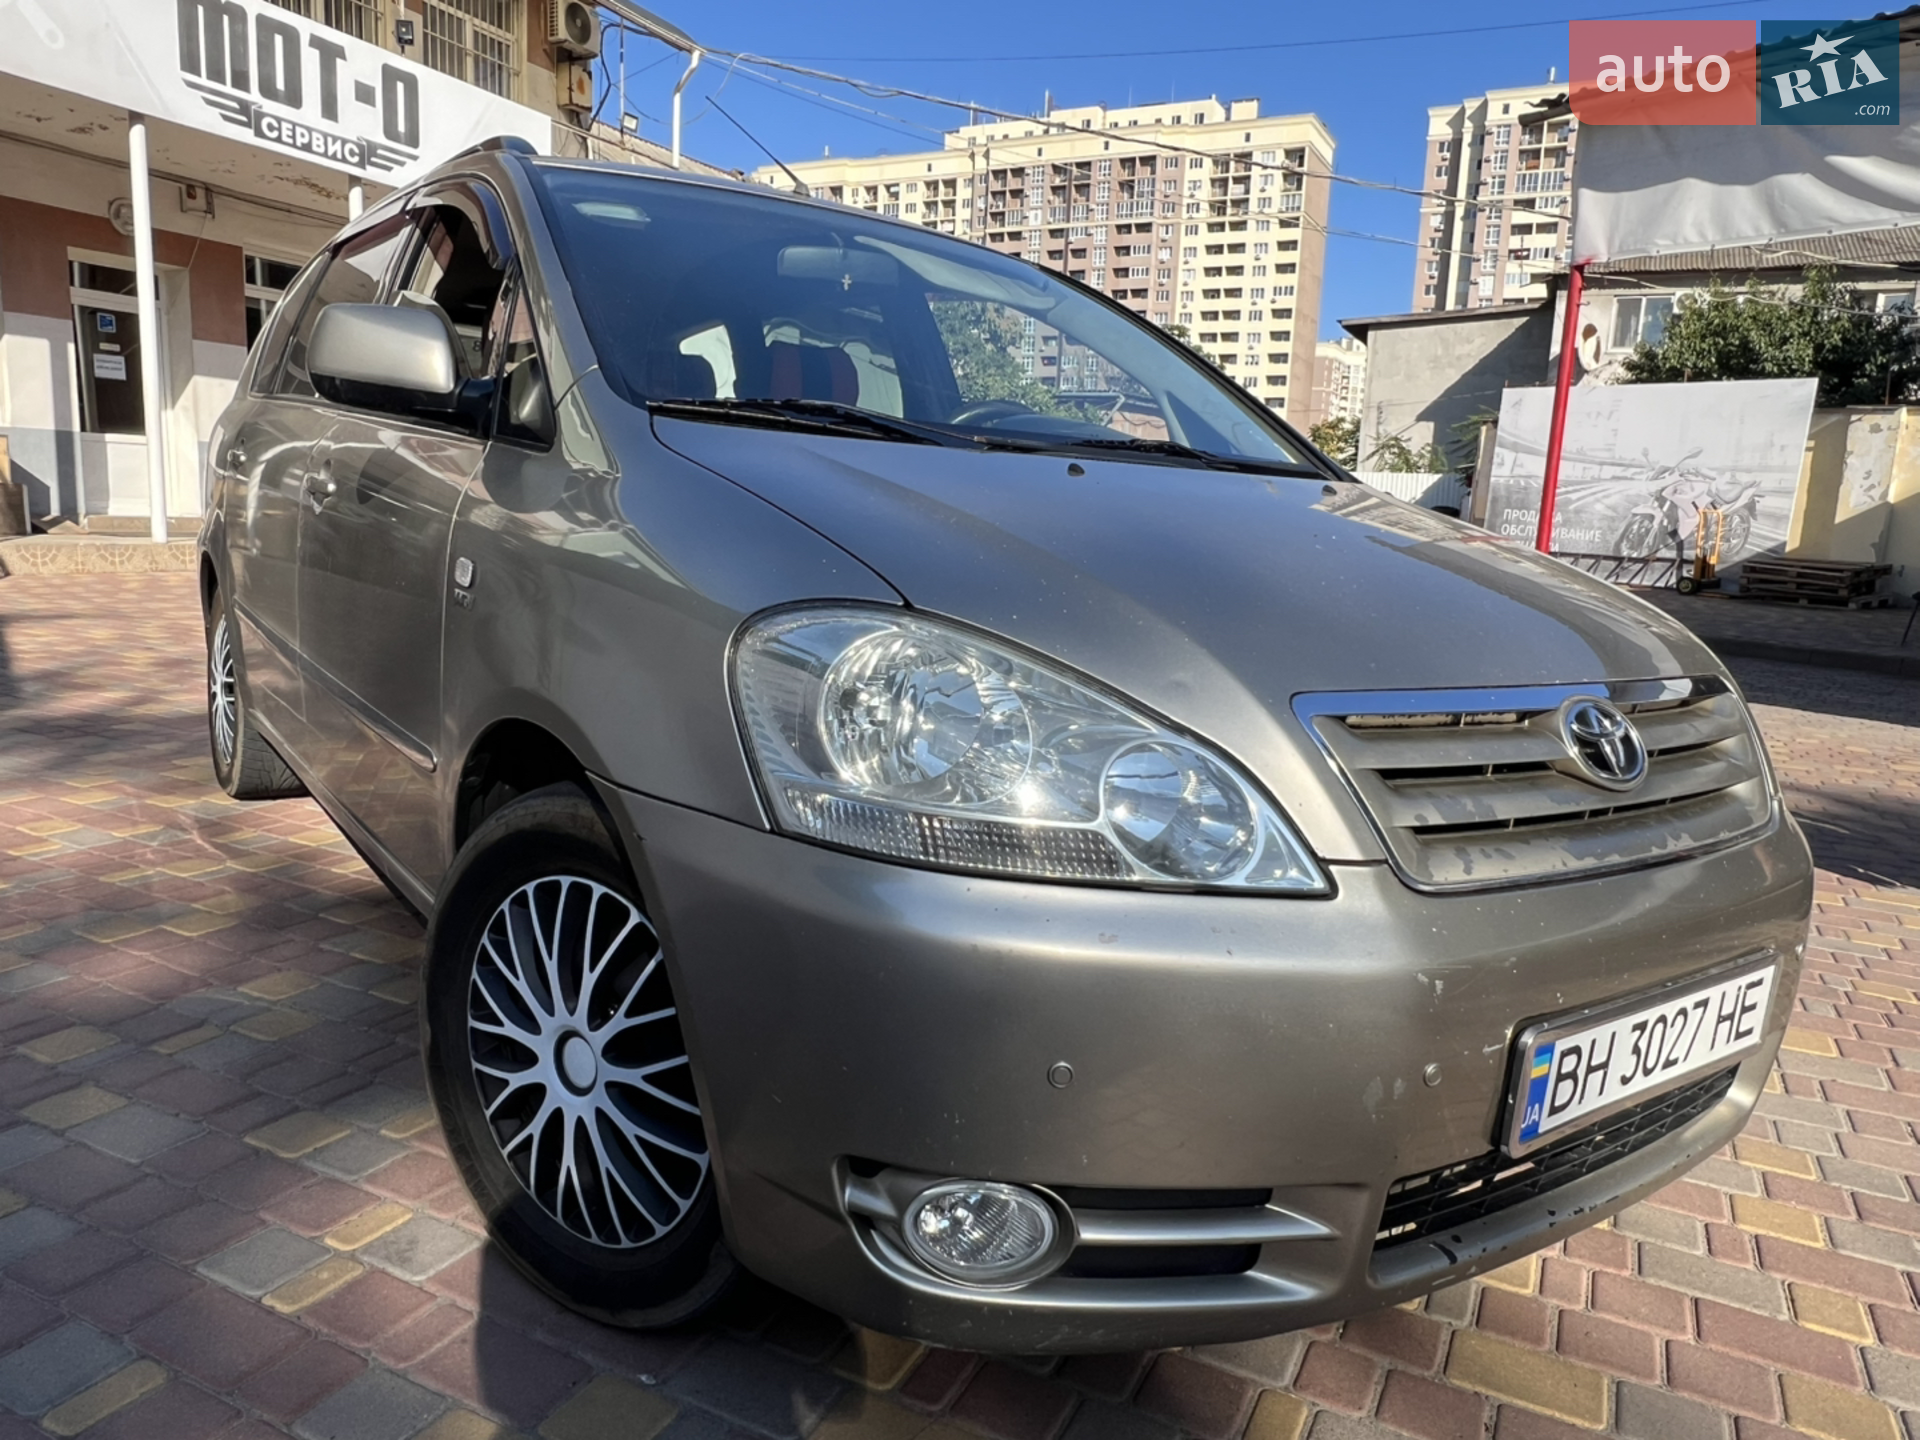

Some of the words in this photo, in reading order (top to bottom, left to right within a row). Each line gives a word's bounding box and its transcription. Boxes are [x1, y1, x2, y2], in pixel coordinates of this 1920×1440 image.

[261, 116, 359, 165] СЕРВИС
[1503, 508, 1563, 524] ПРОДА
[1547, 1031, 1616, 1118] BH
[1620, 996, 1710, 1087] 3027
[1710, 977, 1764, 1051] HE
